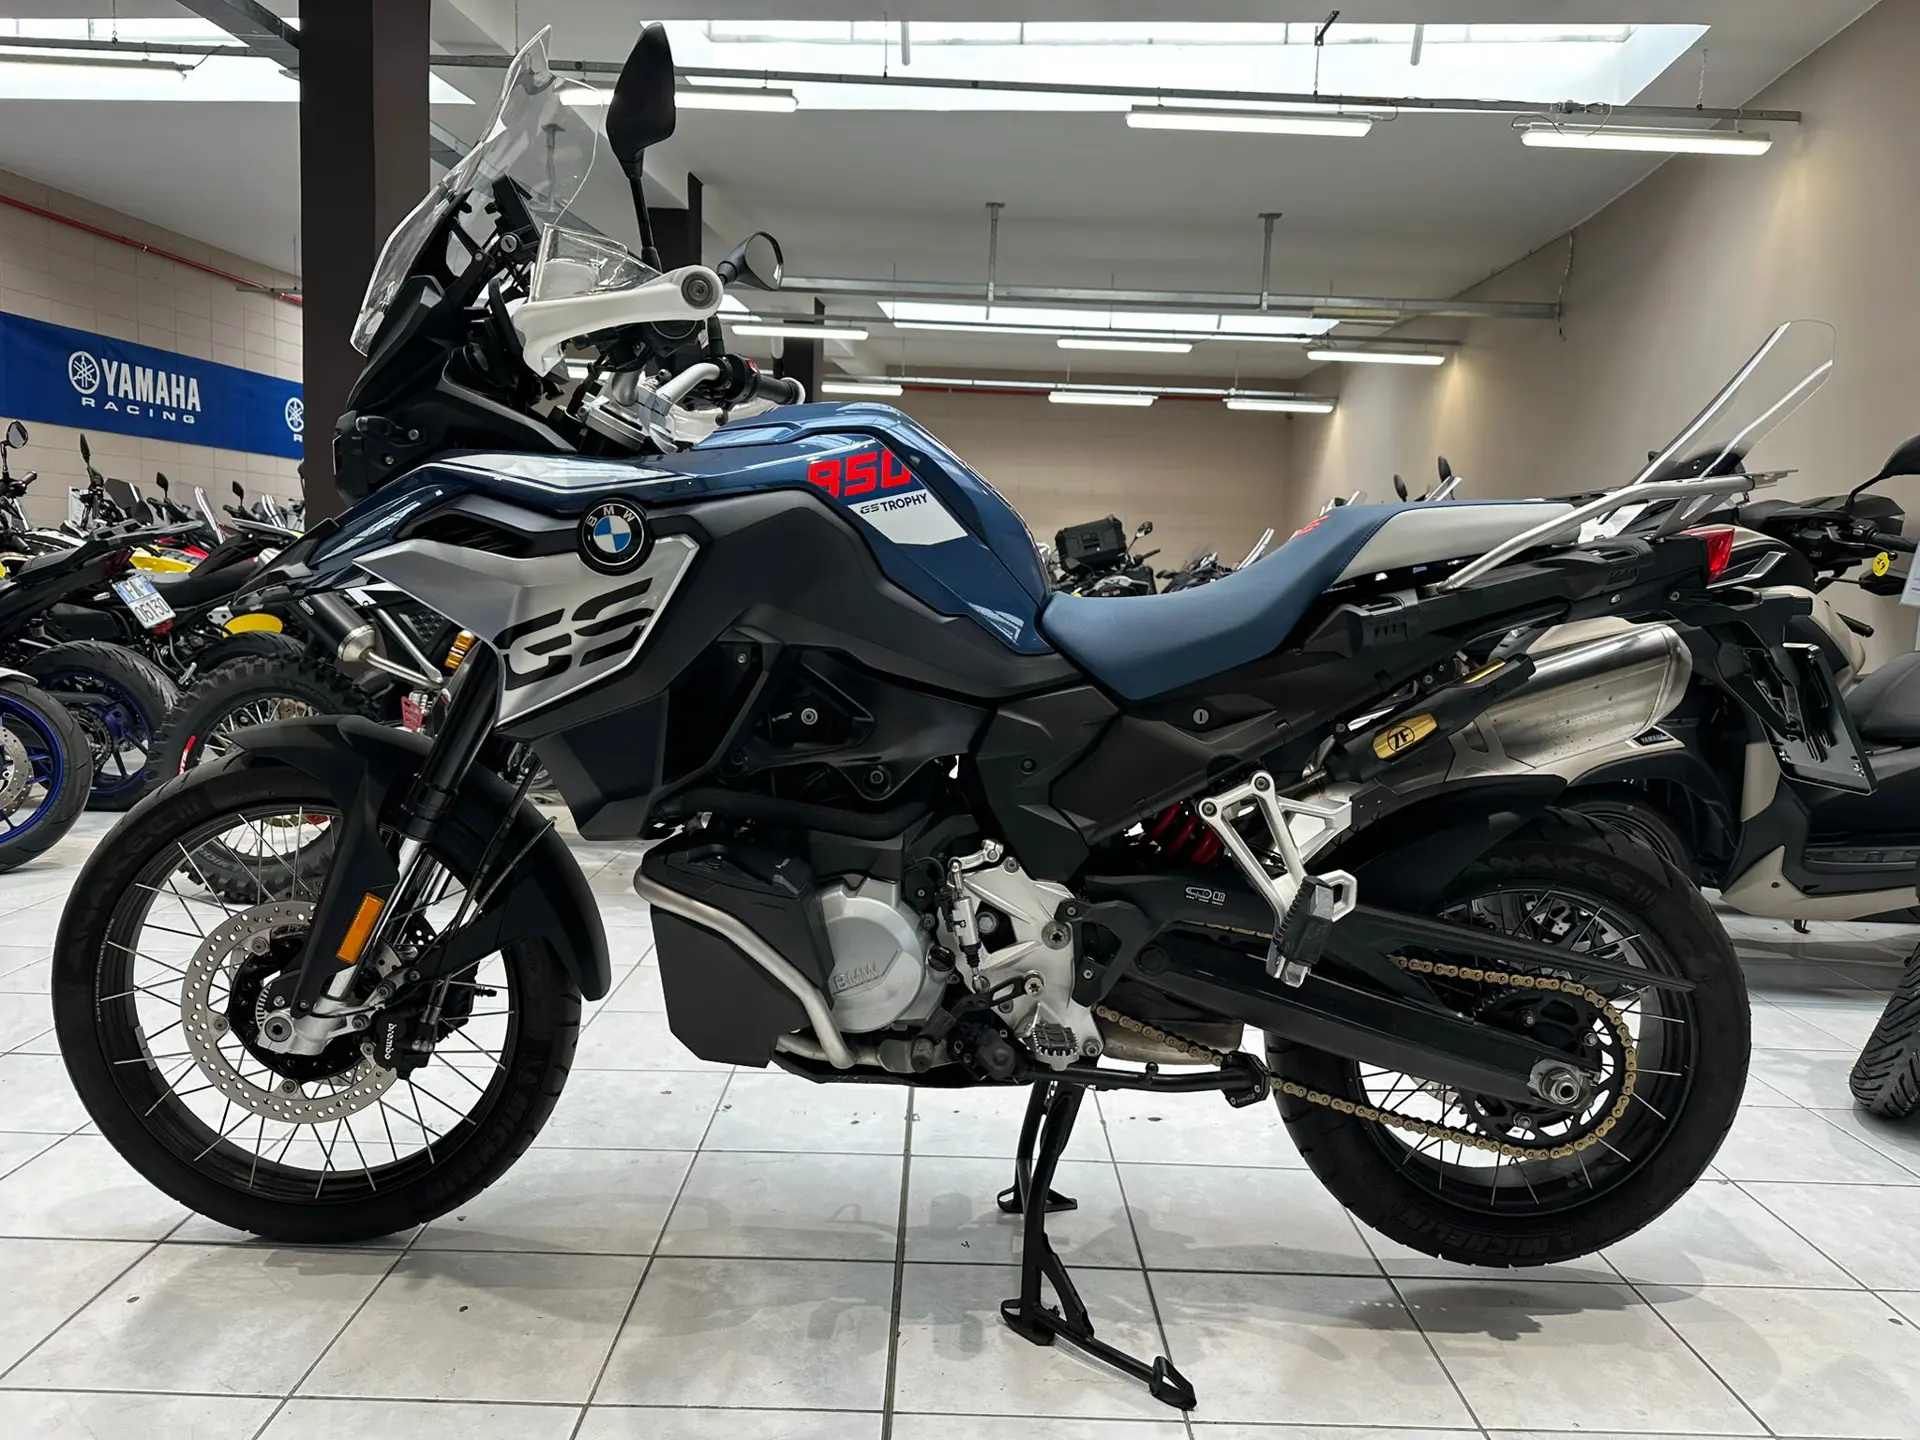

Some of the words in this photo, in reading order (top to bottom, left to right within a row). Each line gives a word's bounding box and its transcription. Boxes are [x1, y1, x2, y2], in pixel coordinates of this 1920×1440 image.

[101, 358, 201, 412] YAMAHA
[82, 397, 195, 424] RACING
[586, 505, 636, 529] BMW
[860, 503, 880, 514] GS
[880, 493, 928, 512] TROPHY
[134, 597, 170, 622] 06130
[493, 577, 655, 690] GS
[833, 962, 877, 991] BMW
[384, 1022, 398, 1060] brembo
[1398, 1208, 1550, 1257] MICHELIN
